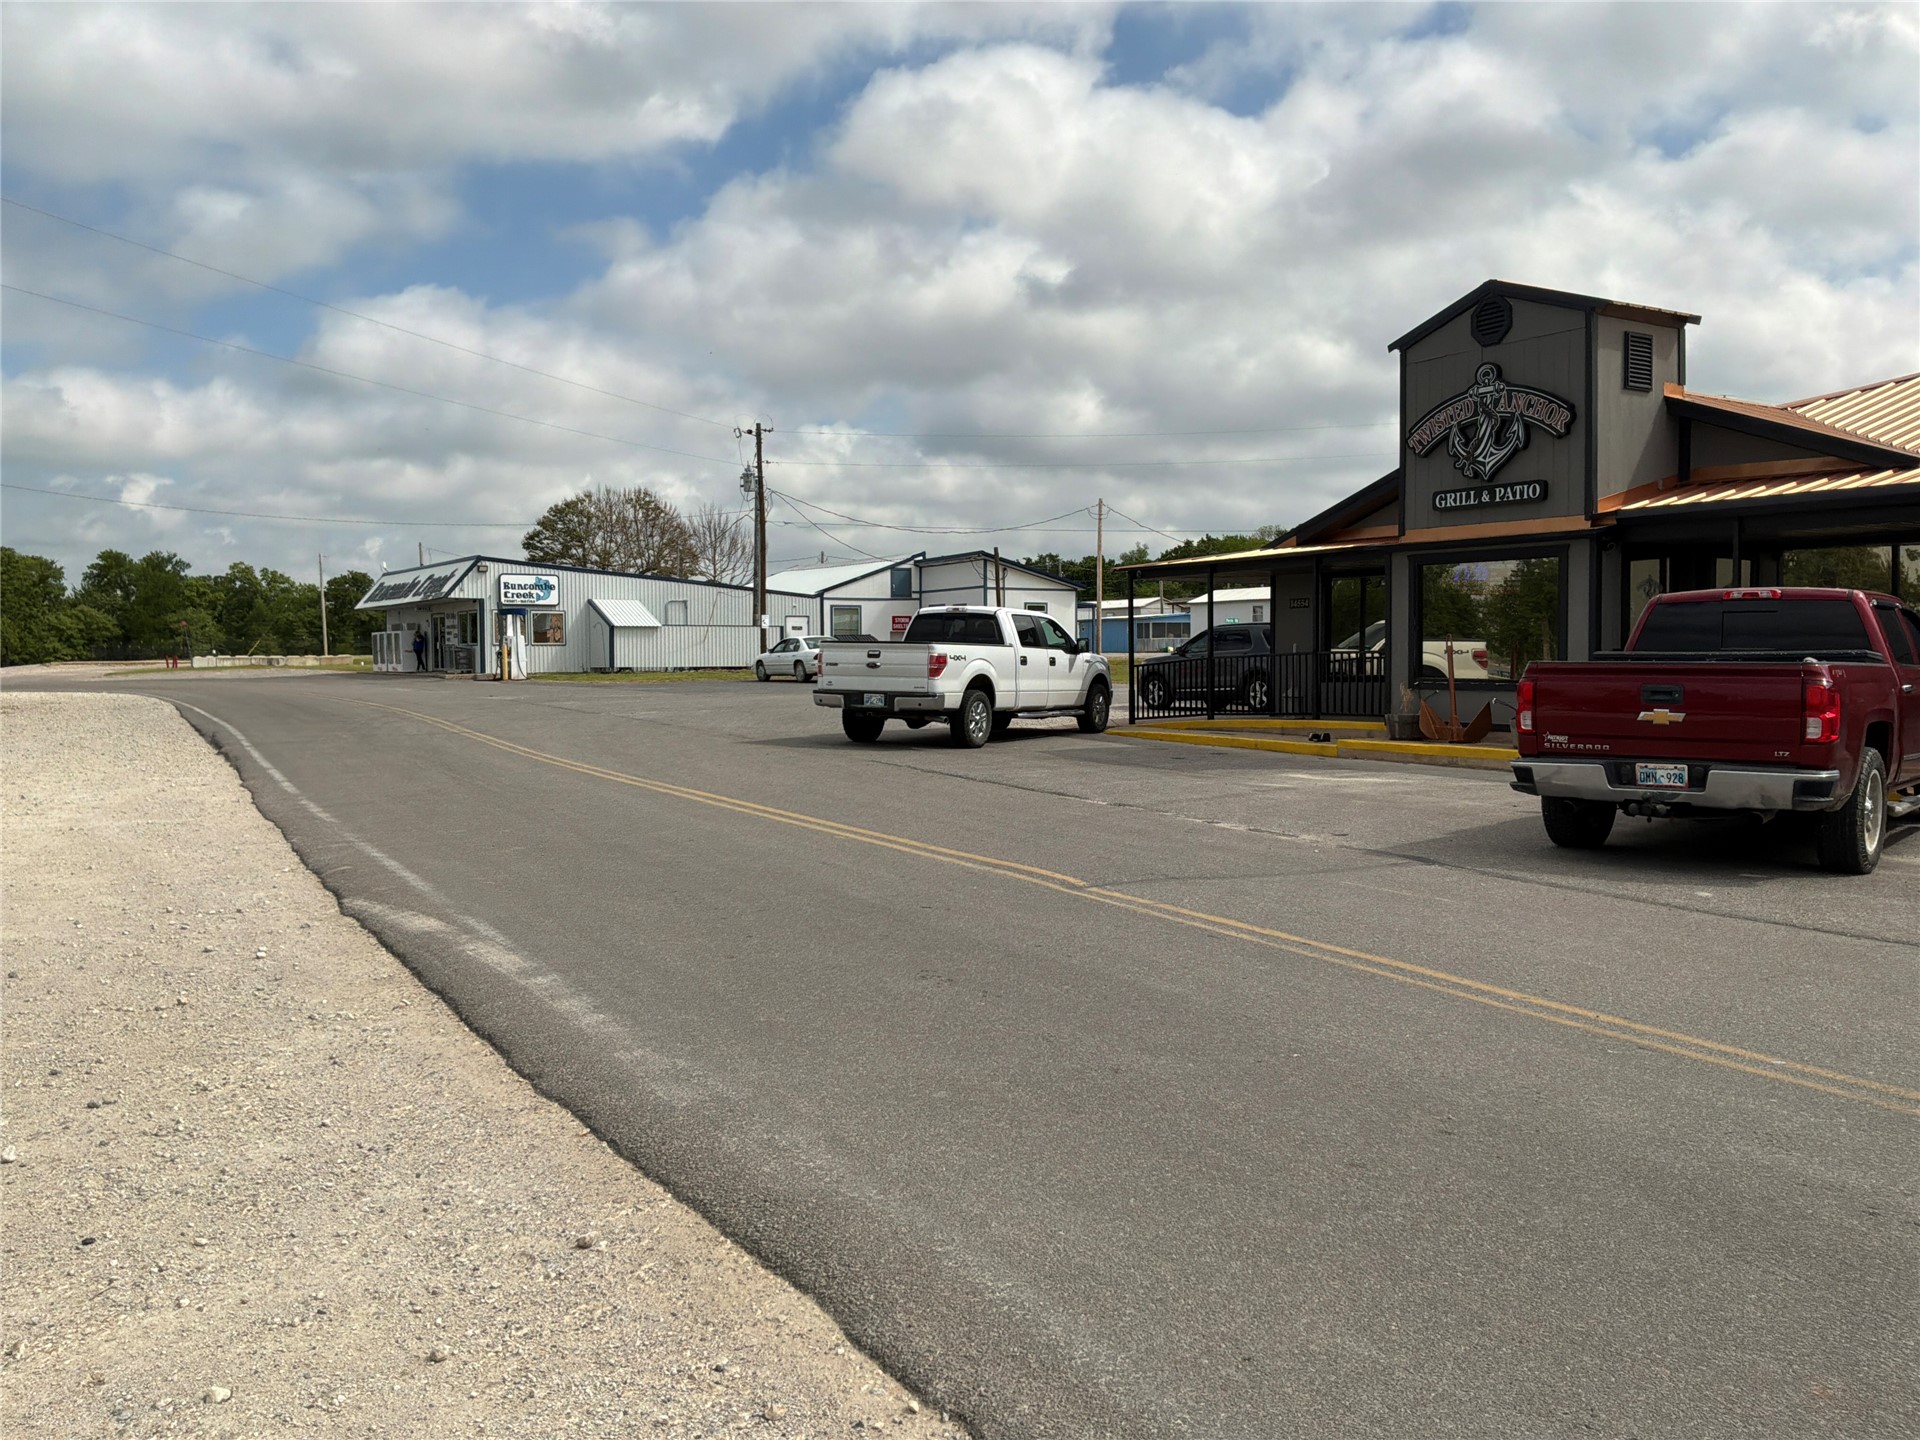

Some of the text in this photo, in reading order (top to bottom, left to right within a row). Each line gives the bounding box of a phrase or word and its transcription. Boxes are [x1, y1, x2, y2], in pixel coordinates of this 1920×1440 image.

[1408, 391, 1571, 454] TWISTED ANCHOR
[1435, 483, 1541, 508] GRILL & PATIO
[503, 581, 556, 591] Buncombe
[503, 591, 535, 599] Creek
[1543, 742, 1610, 751] SILVERADO
